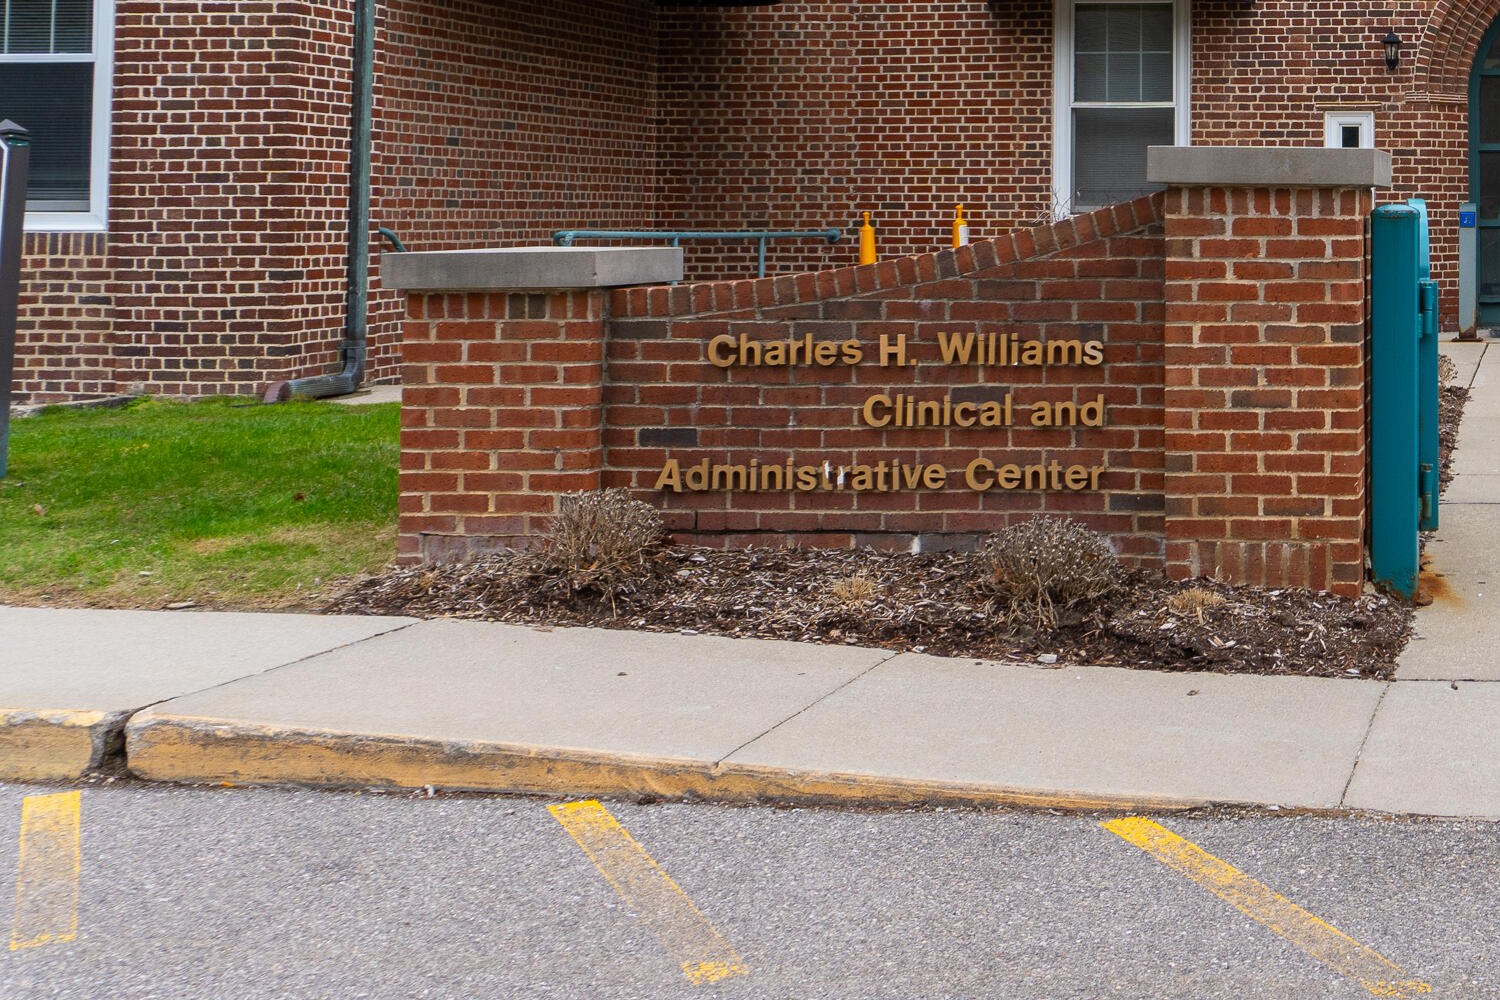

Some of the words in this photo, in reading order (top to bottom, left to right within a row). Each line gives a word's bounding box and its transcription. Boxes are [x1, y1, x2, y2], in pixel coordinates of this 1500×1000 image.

[707, 332, 862, 368] Charles
[879, 333, 917, 367] H.
[937, 331, 1104, 367] Williams
[863, 393, 1013, 428] Clinical
[1030, 393, 1105, 427] and
[655, 457, 947, 493] Administrative
[965, 457, 1105, 492] Center
